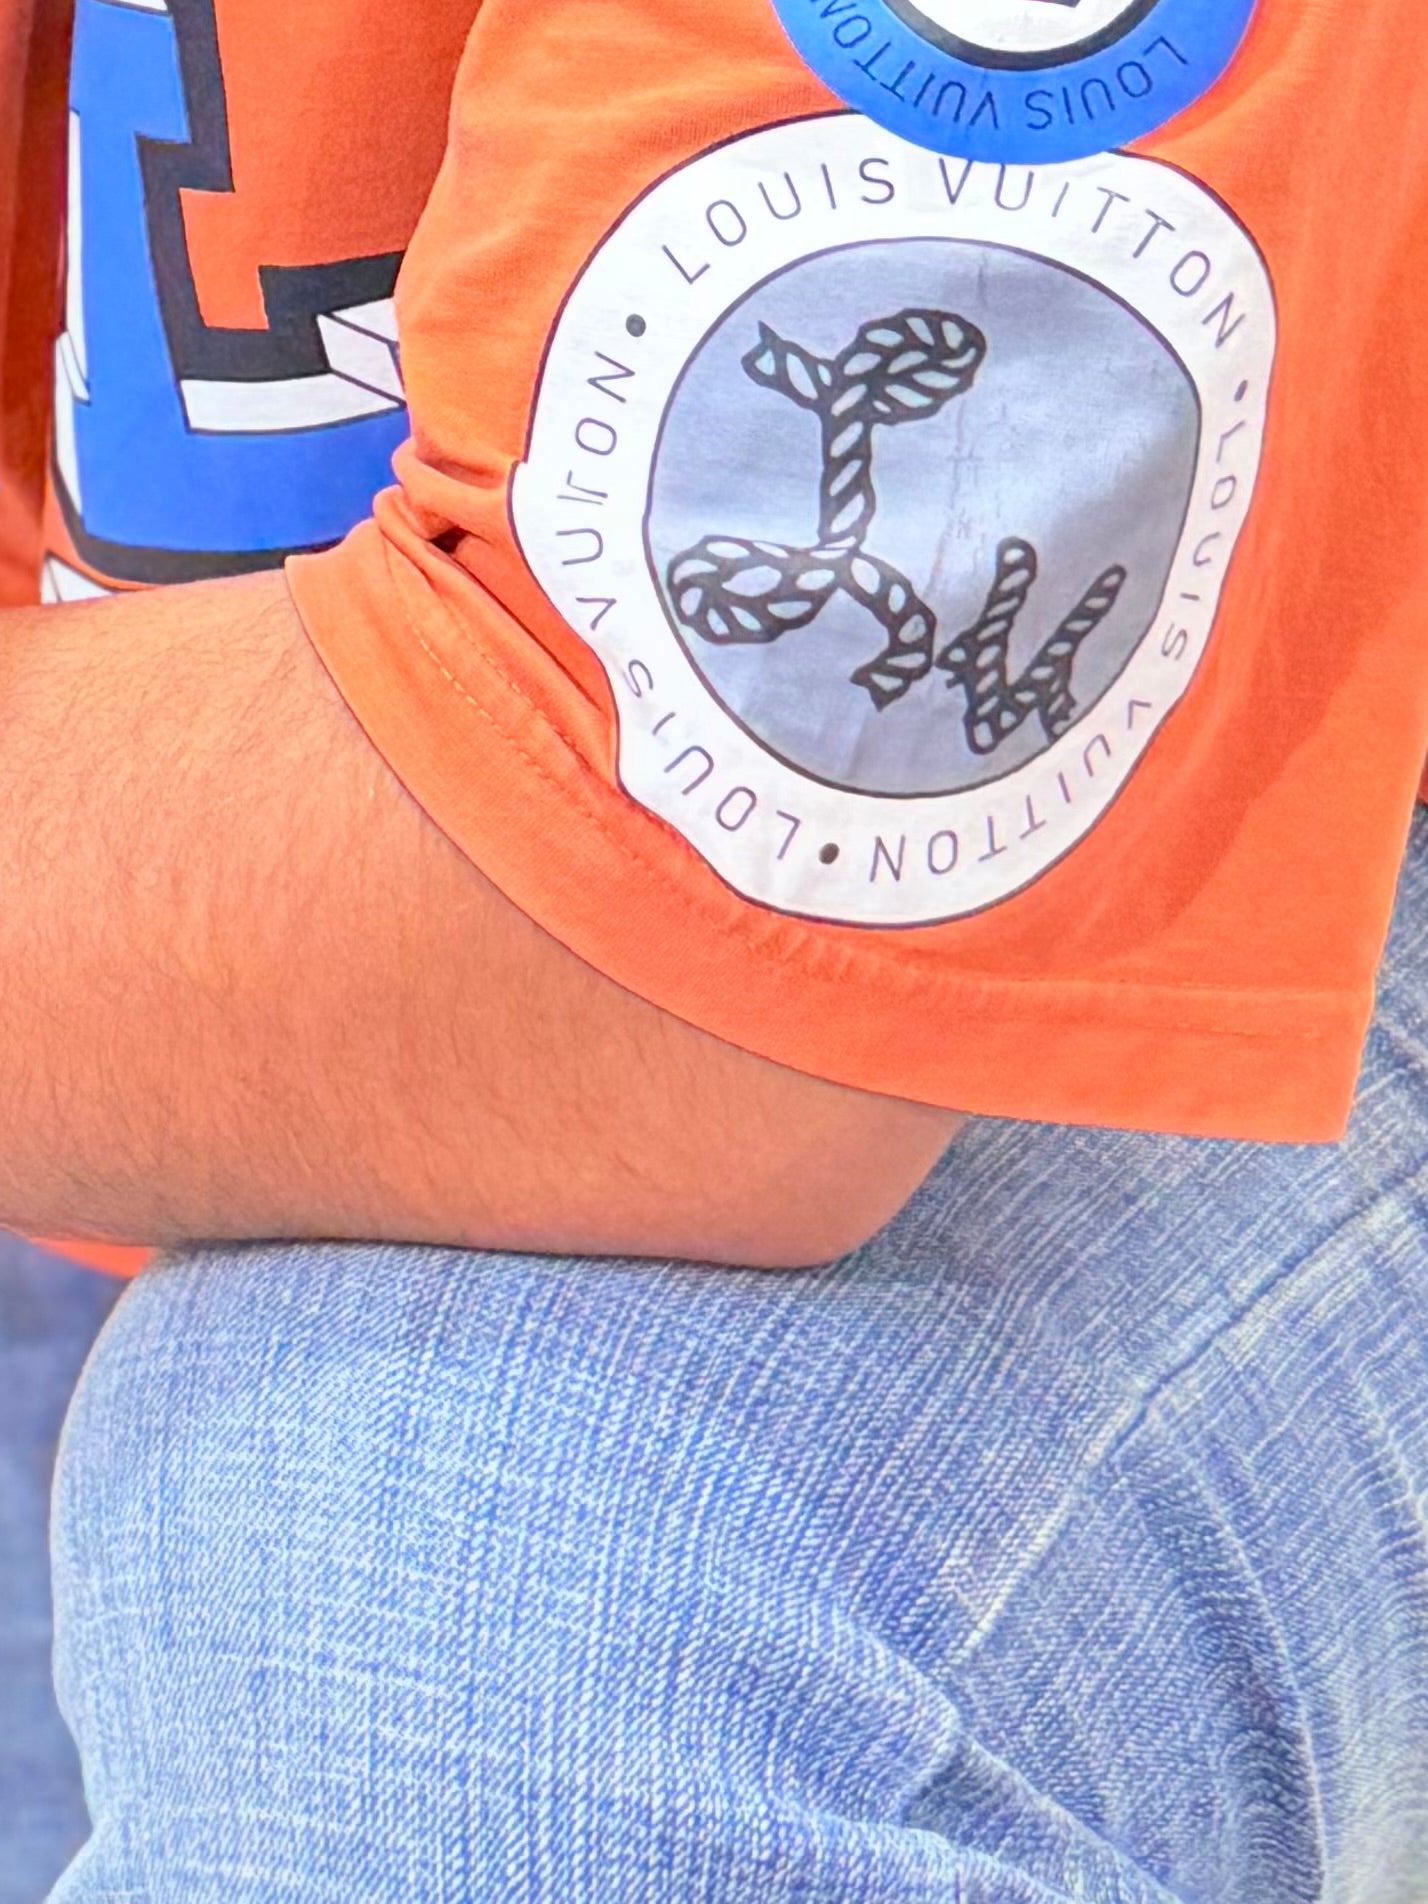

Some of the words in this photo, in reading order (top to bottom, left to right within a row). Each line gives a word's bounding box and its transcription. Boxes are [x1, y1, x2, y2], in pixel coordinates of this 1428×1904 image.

[1025, 35, 1189, 130] LOUIS
[662, 157, 896, 285] LOUIS
[938, 156, 1246, 349] VUITTON
[1161, 420, 1247, 662] LOUIS
[623, 659, 801, 860] LOUIS
[869, 698, 1152, 883] VUITTON
